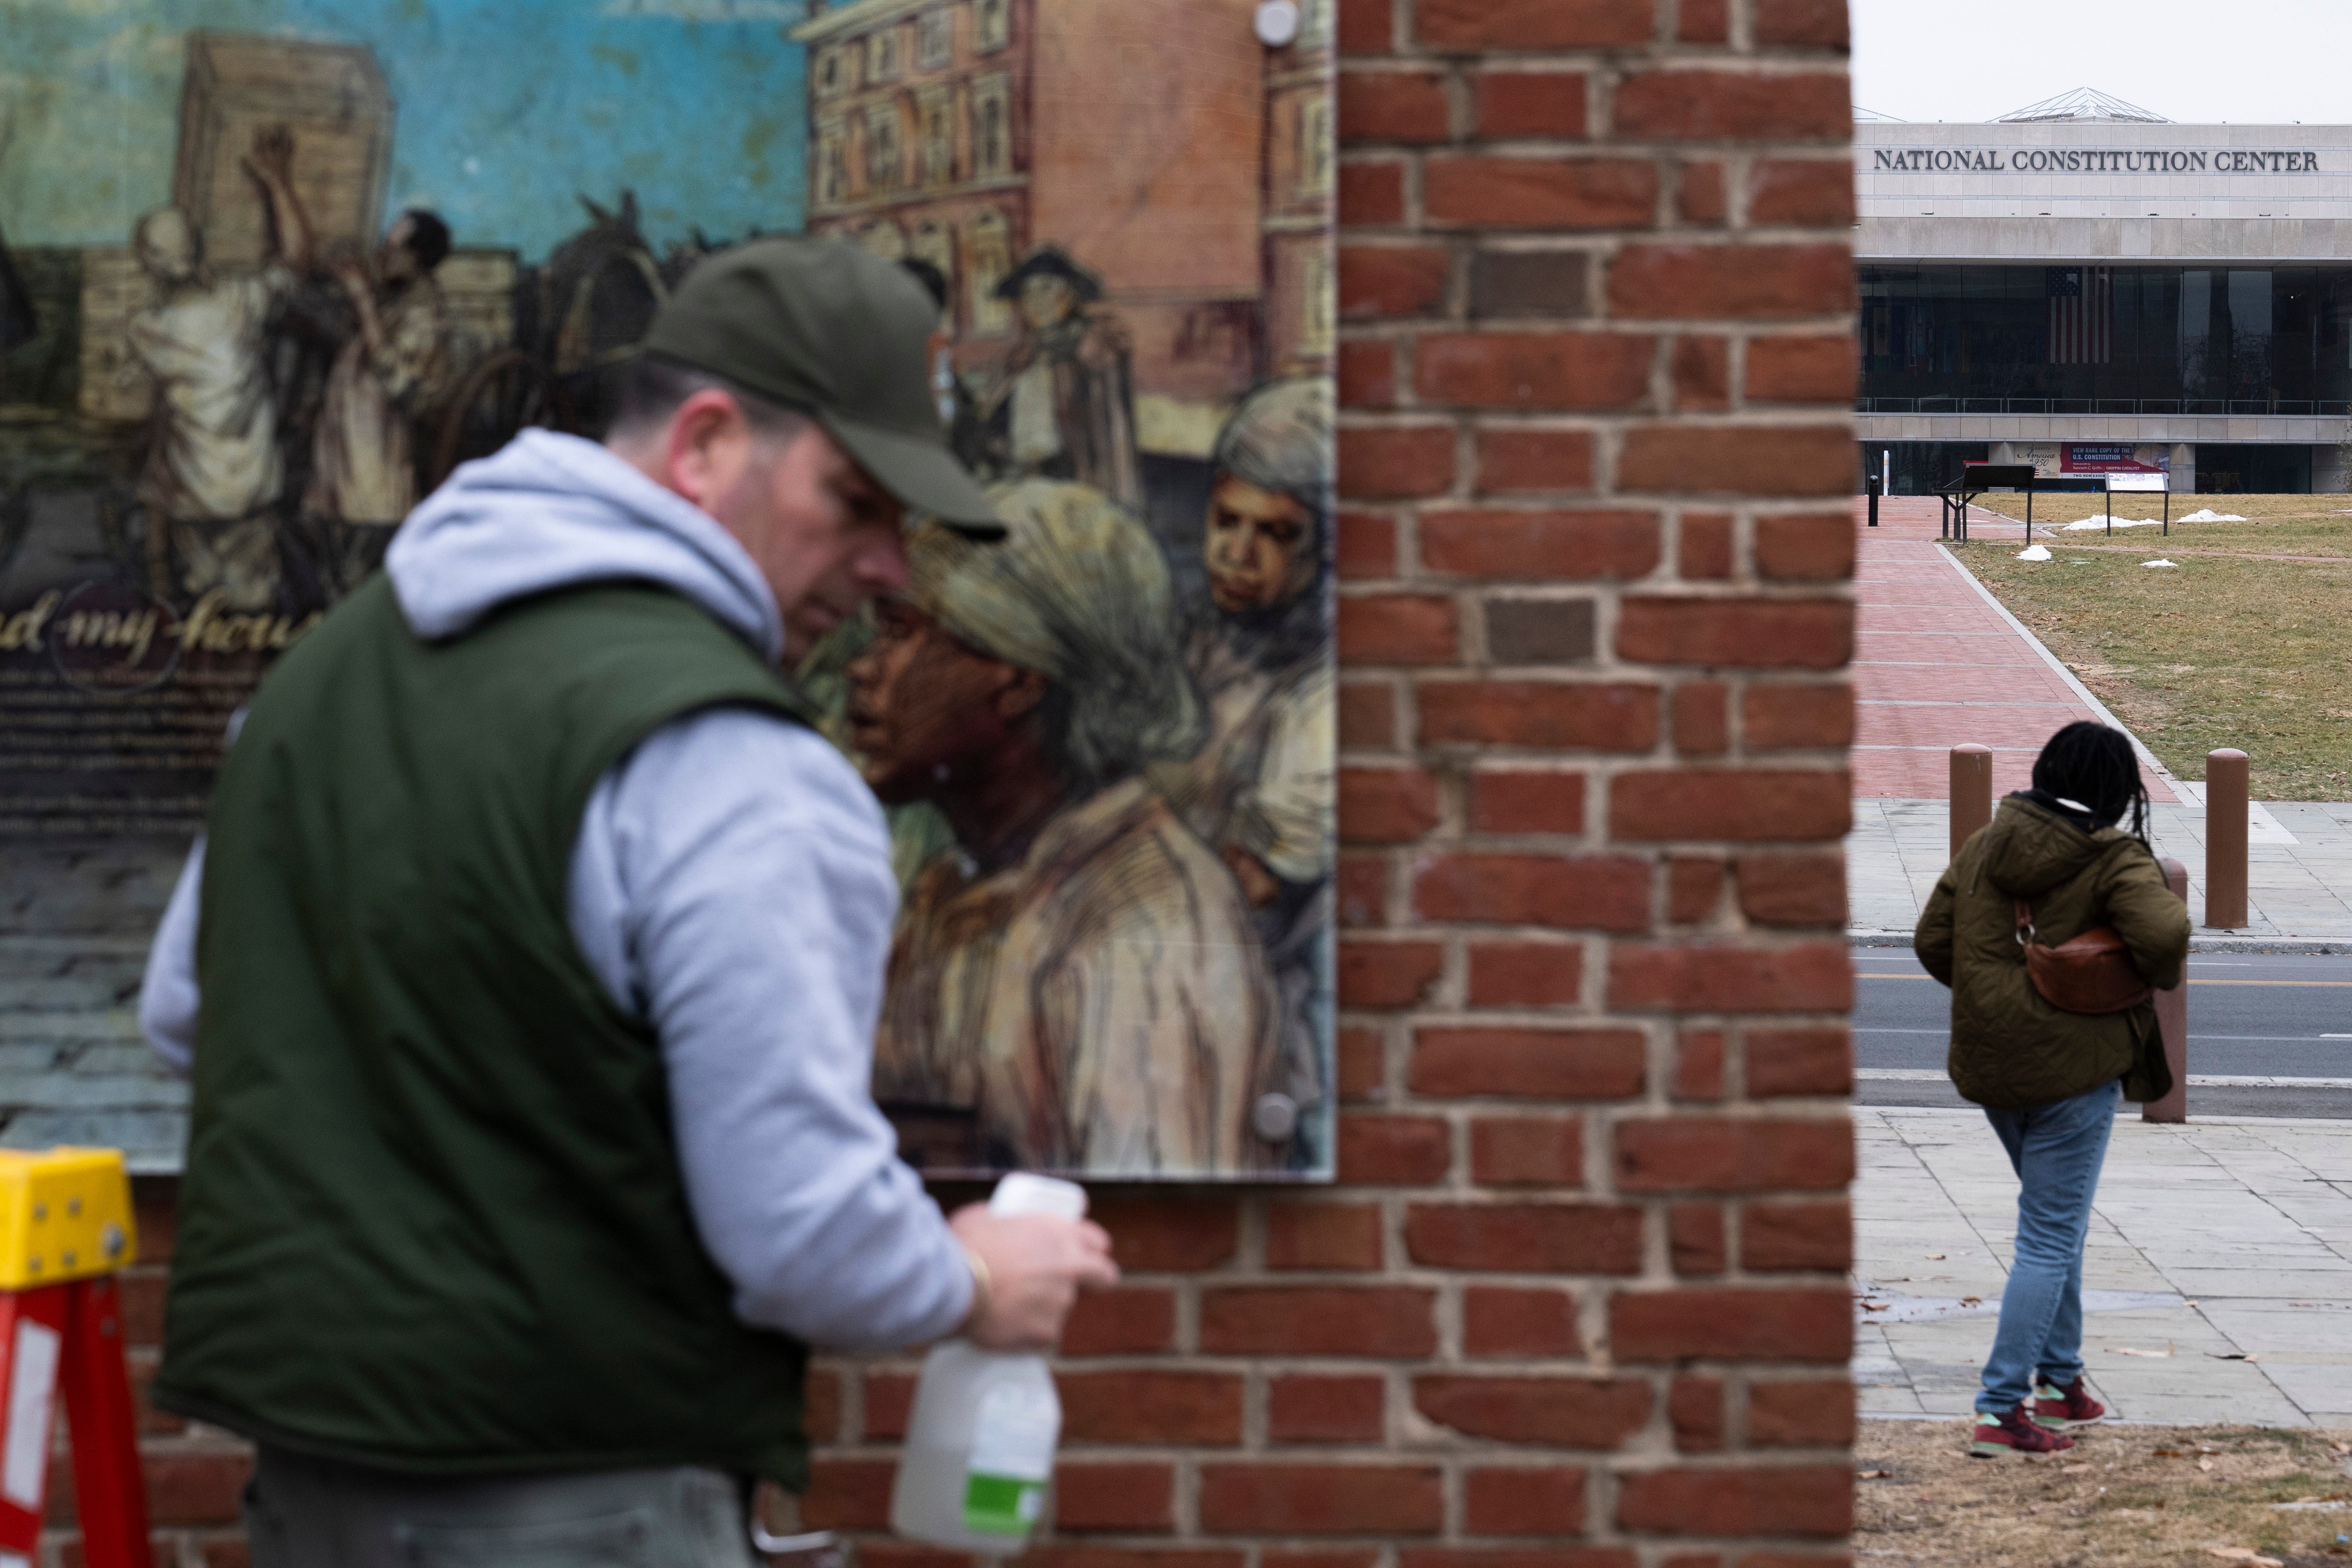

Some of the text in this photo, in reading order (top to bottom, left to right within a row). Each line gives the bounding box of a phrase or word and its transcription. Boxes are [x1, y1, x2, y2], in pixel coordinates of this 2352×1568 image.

[1874, 150, 2319, 171] NATIONAL CONSTITUTION CENTER
[2017, 449, 2056, 459] America
